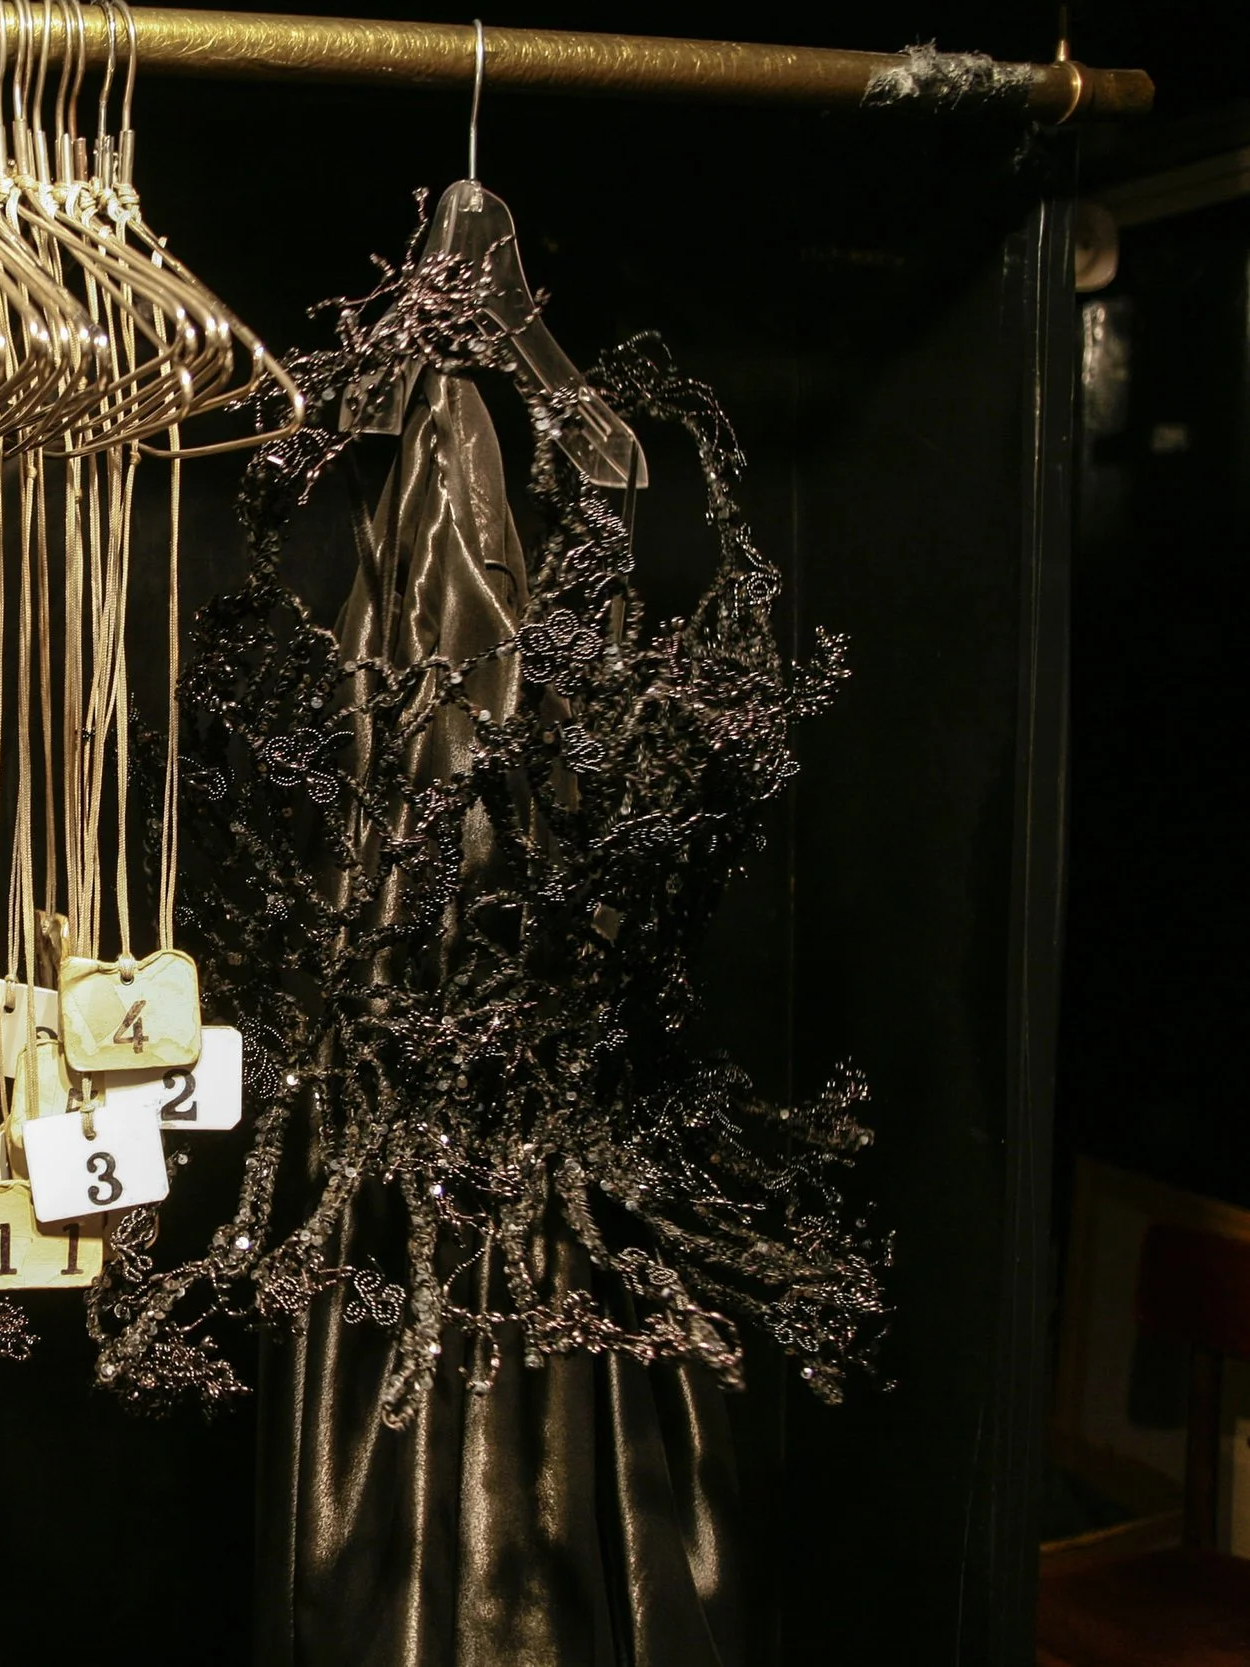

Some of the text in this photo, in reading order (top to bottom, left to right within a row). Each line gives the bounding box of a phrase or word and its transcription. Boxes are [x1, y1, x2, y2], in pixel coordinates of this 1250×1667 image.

[113, 1000, 150, 1054] 4
[161, 1067, 198, 1122] 2
[86, 1151, 124, 1206] 3
